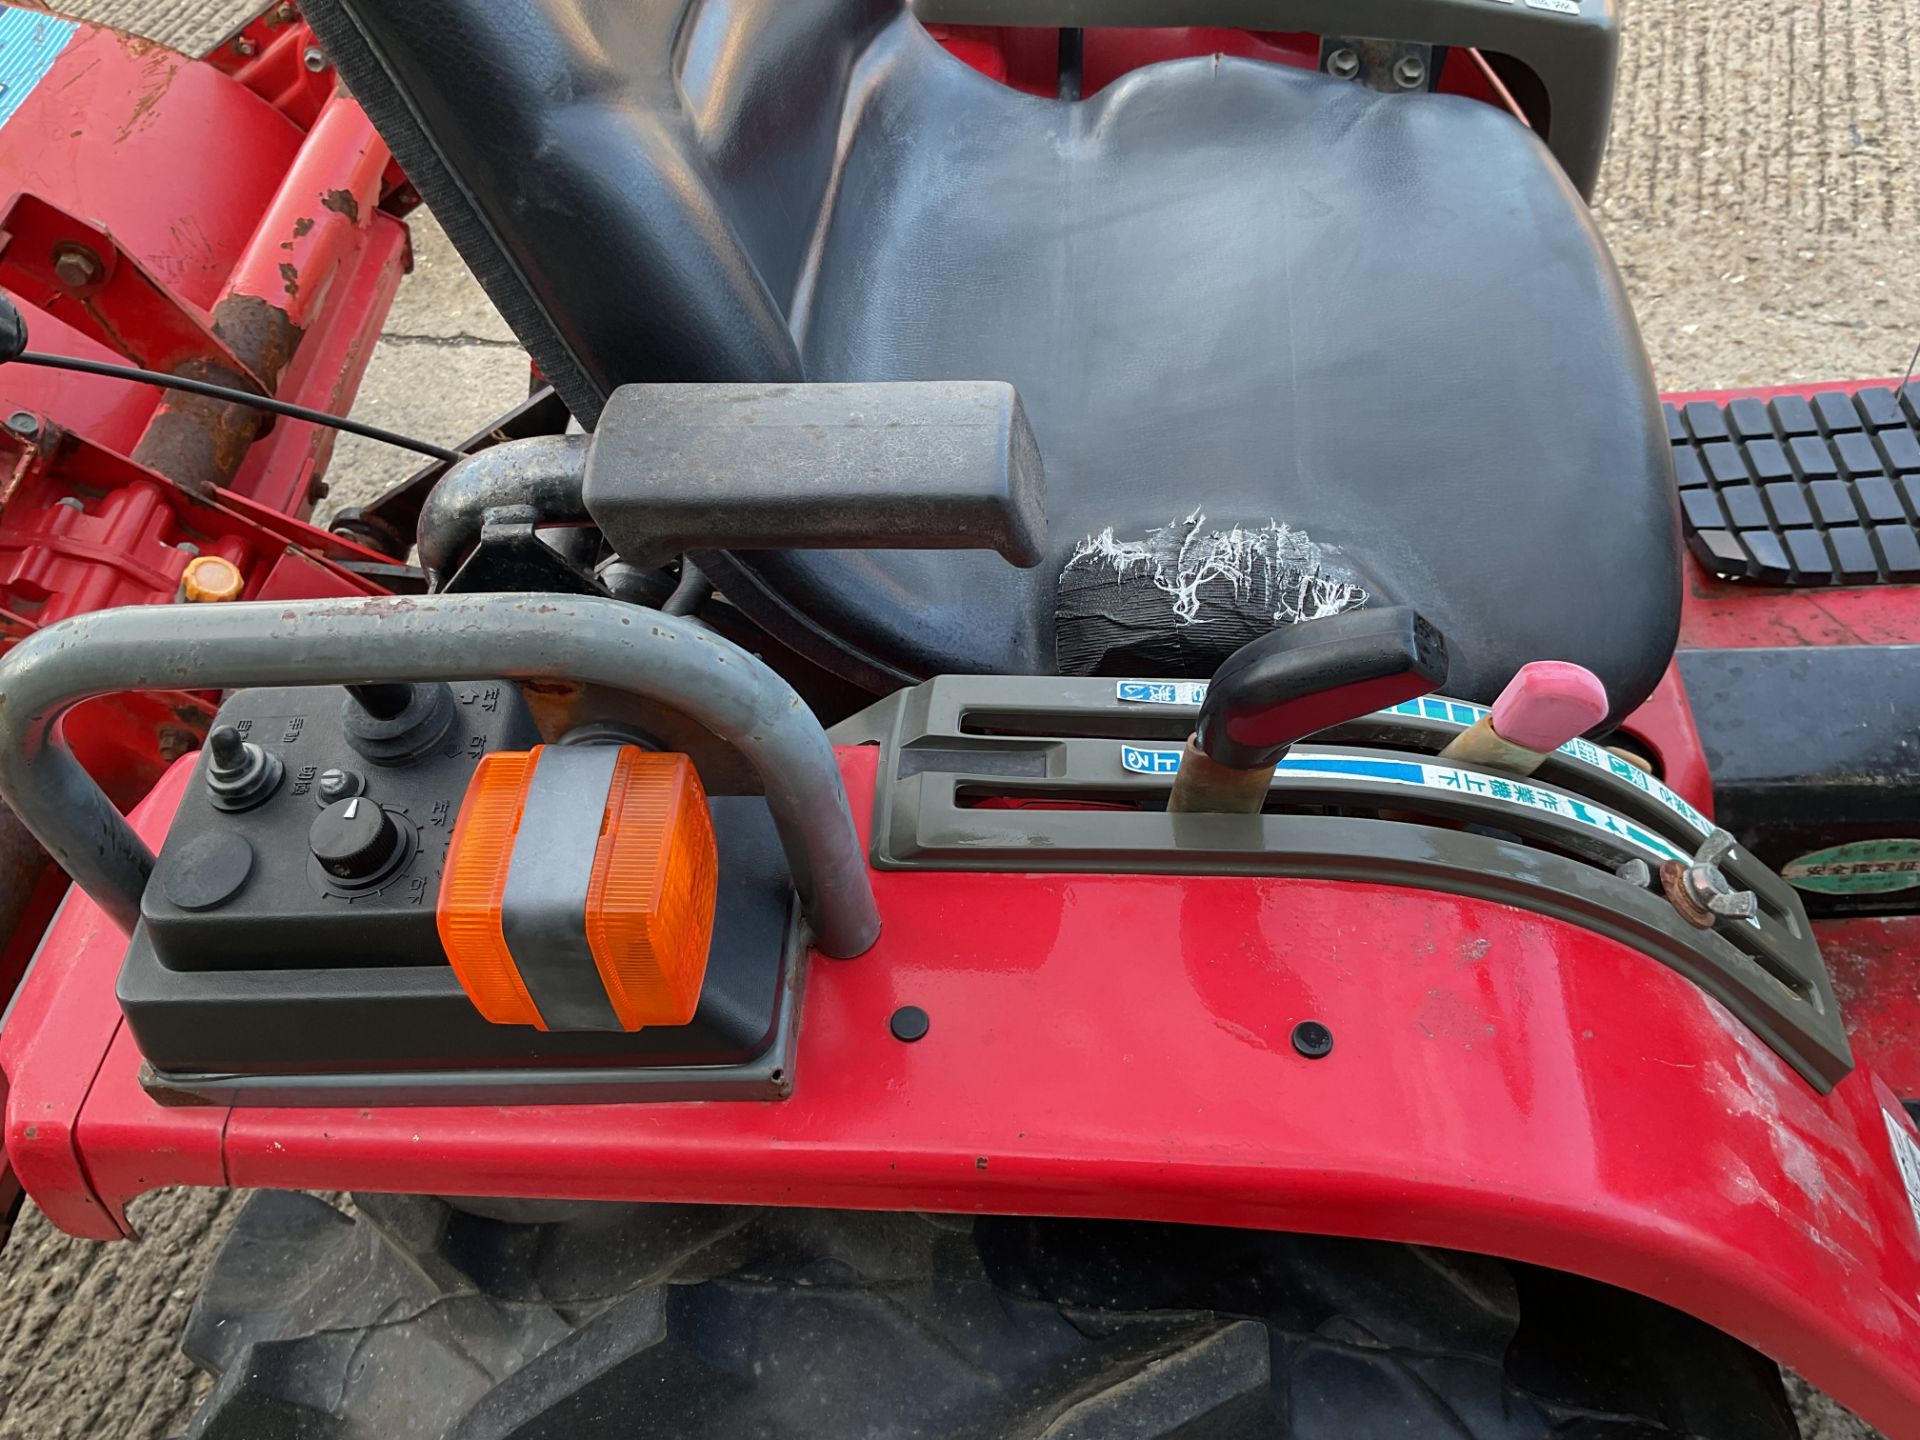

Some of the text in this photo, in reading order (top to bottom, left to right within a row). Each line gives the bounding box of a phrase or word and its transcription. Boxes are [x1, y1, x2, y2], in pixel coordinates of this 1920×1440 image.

[1127, 750, 1177, 772] 上る
[1438, 770, 1558, 811] 作業機上下
